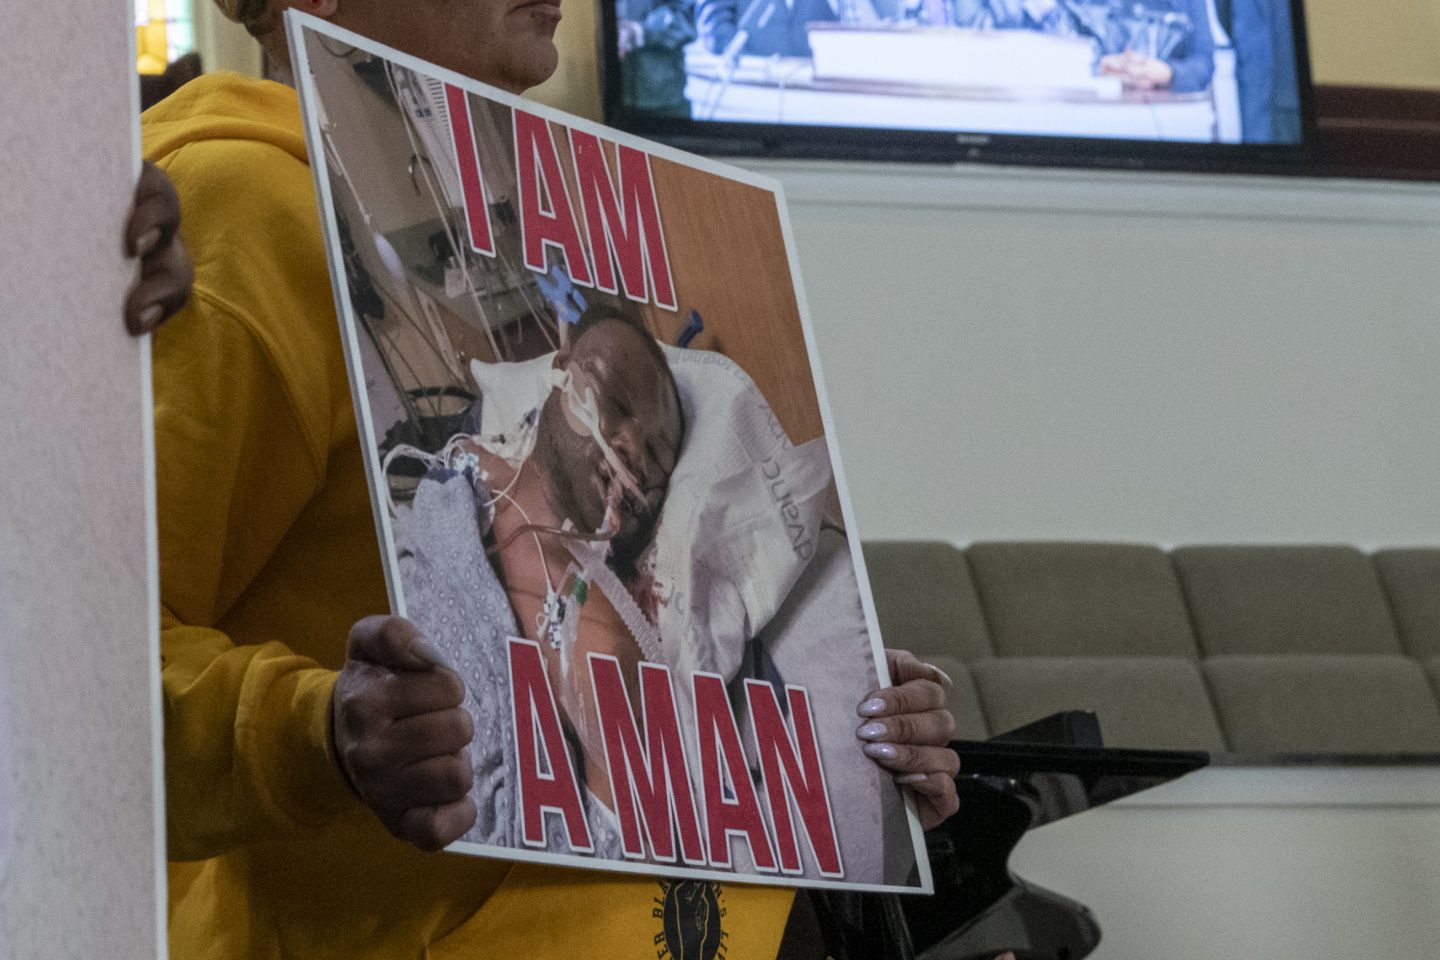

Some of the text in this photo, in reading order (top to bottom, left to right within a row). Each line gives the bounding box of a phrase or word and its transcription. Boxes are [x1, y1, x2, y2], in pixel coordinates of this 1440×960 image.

[441, 80, 678, 312] I AM
[761, 457, 814, 561] dvanc
[506, 636, 844, 878] A MAN
[654, 931, 669, 960] ER
